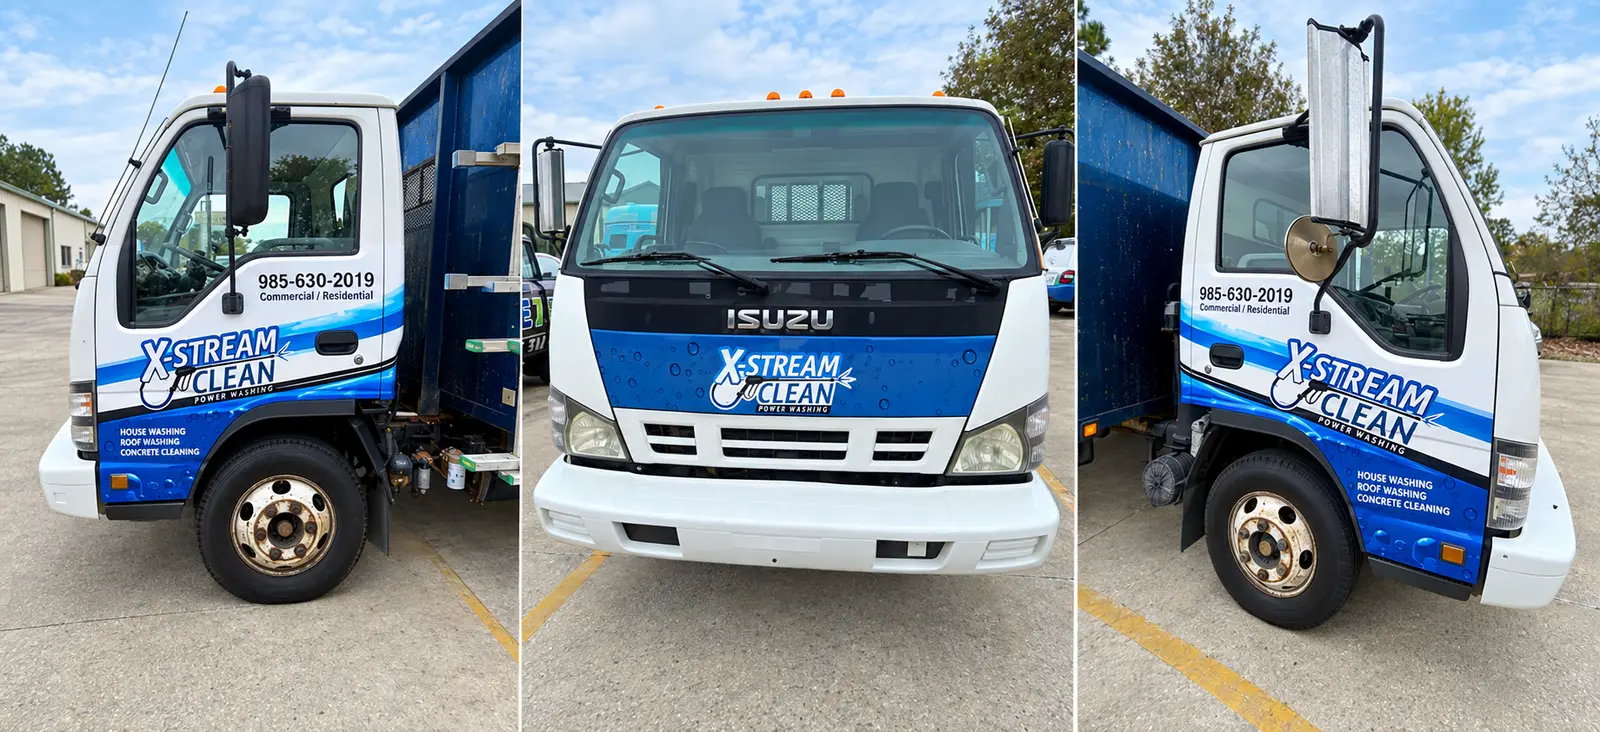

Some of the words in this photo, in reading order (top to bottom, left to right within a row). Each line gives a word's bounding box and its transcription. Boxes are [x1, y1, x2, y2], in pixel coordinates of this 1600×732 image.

[258, 271, 375, 289] 985-630-2019
[259, 291, 315, 301] Commercial
[322, 290, 374, 300] Residential
[1199, 286, 1293, 303] 985-630-2019
[1199, 302, 1241, 312] Commercial
[1246, 304, 1290, 315] Residential
[727, 309, 834, 330] ISUZU
[140, 328, 279, 383] X-STREAM
[715, 347, 841, 385] X-STREAM
[192, 359, 276, 394] CLEAN
[1276, 340, 1435, 417] X-STREAM
[194, 392, 227, 405] POWER
[230, 385, 275, 398] WASHING
[757, 382, 835, 404] CLEAN
[788, 405, 829, 413] WASHING
[1320, 393, 1419, 446] CLEAN
[120, 428, 147, 436] HOUSE
[148, 427, 187, 436] WASHING
[1317, 416, 1352, 435] POWER
[1355, 429, 1406, 456] WASHING
[120, 438, 142, 446] ROOF
[143, 438, 180, 446] WASHING
[120, 448, 160, 456] CONCRETE
[160, 448, 200, 456] CLEANING
[1357, 470, 1387, 483] HOUSE
[1388, 475, 1433, 490] WASHING
[1357, 482, 1381, 494] ROOF
[1383, 485, 1427, 500] WASHING
[1356, 493, 1402, 508] CONCRETE
[1403, 500, 1451, 516] CLEANING
